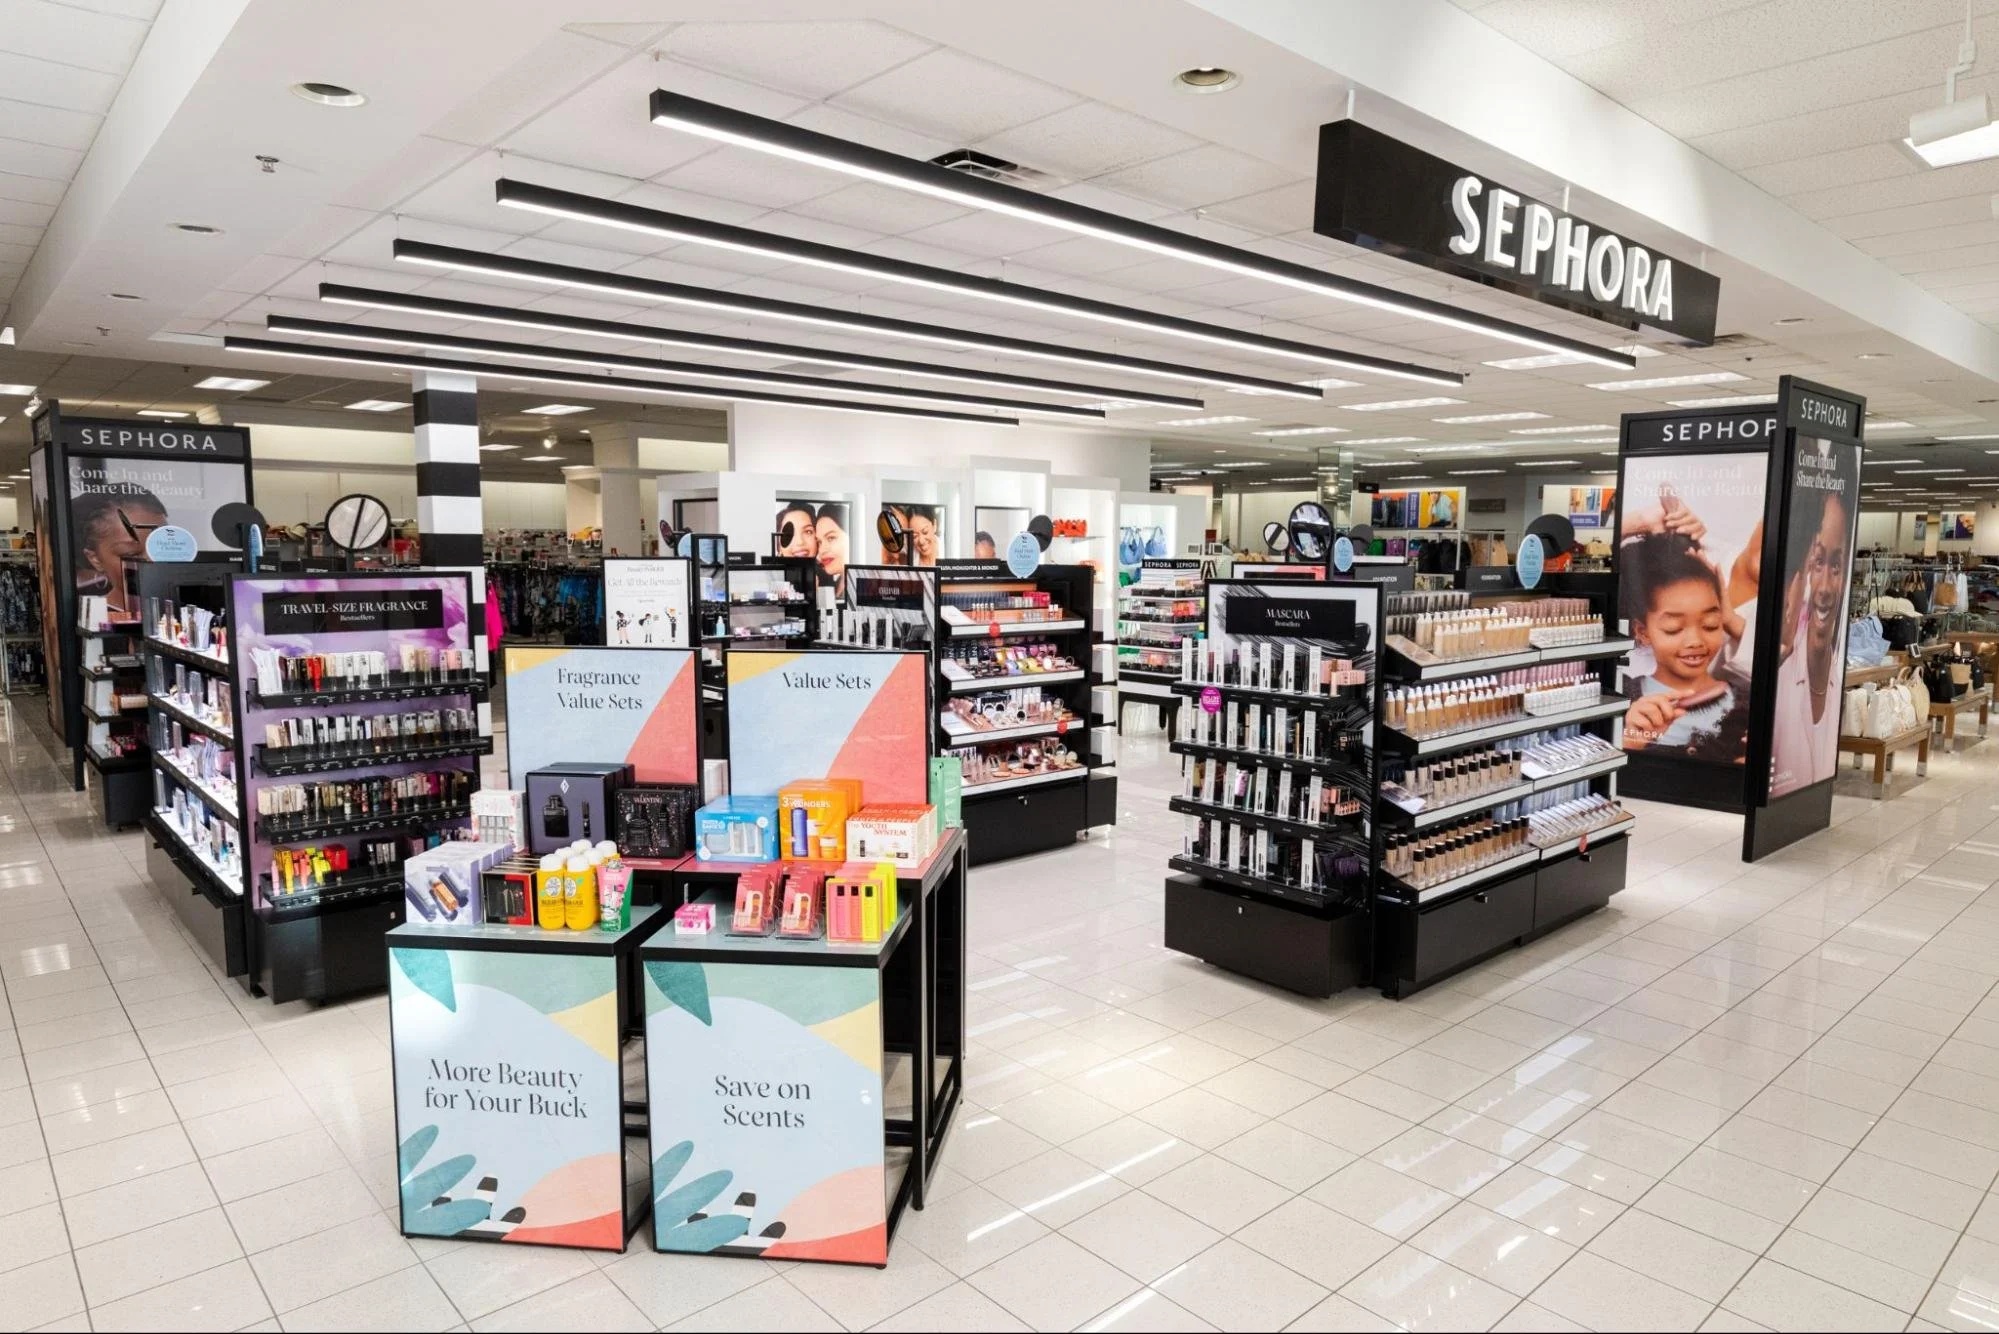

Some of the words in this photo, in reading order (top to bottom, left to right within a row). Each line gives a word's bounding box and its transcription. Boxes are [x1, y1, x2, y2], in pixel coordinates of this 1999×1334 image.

[1448, 175, 1674, 321] SEPHORA
[1801, 398, 1848, 428] SEPHORA
[81, 428, 217, 451] SEPHORA
[1798, 449, 1817, 468] Come
[69, 466, 118, 481] Come
[122, 467, 139, 481] In
[142, 468, 174, 482] and
[1796, 471, 1814, 488] Share
[1815, 472, 1825, 489] the
[1825, 474, 1846, 494] Beauty
[71, 481, 118, 494] Share
[120, 482, 148, 495] the
[151, 484, 204, 498] Beauty
[280, 602, 357, 616] TRAVEL-SIZE
[359, 600, 428, 613] FRAGRANCE
[1265, 608, 1311, 620] MASCARA
[339, 614, 376, 622] Bestsellers
[557, 668, 641, 688] Fragrance
[782, 672, 831, 689] Value
[835, 673, 871, 690] Sets
[557, 692, 604, 709] Value
[608, 694, 643, 710] Sets
[874, 829, 908, 837] SYSTEM
[428, 1058, 491, 1083] More
[497, 1062, 583, 1095] Beauty
[714, 1074, 770, 1098] Save
[777, 1083, 811, 1100] on
[425, 1086, 459, 1109] for
[464, 1088, 523, 1114] Your
[528, 1093, 588, 1119] Buck
[723, 1104, 806, 1129] Scents
